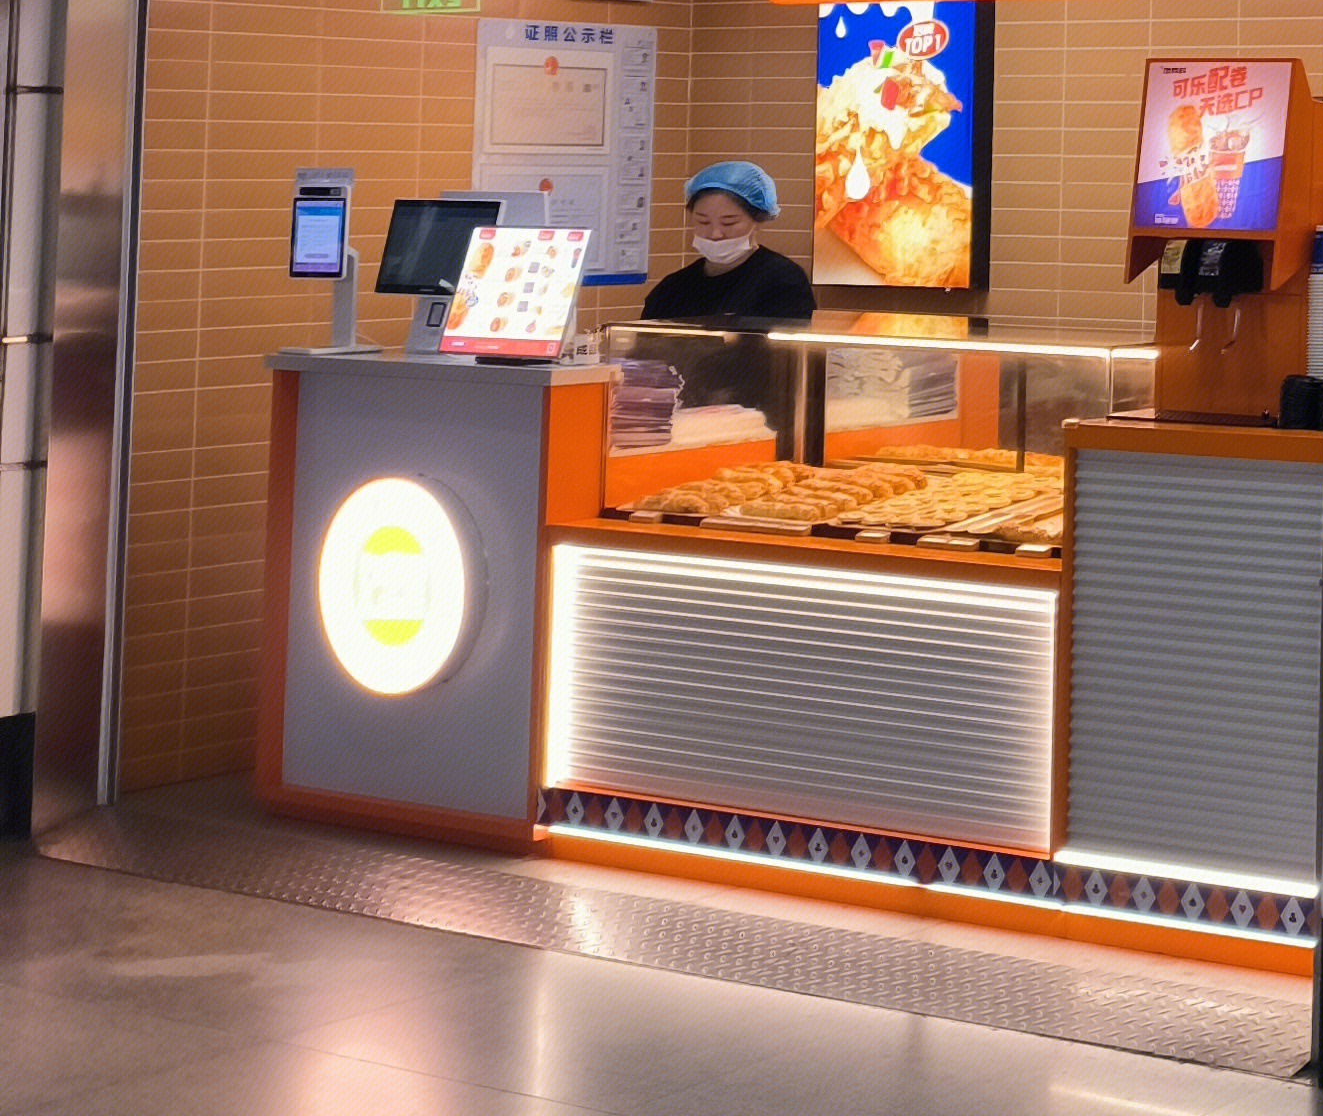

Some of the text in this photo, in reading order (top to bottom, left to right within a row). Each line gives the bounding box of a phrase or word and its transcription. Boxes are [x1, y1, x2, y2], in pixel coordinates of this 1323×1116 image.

[525, 24, 615, 45] 证照公示栏
[1173, 65, 1248, 99] 可乐配卷
